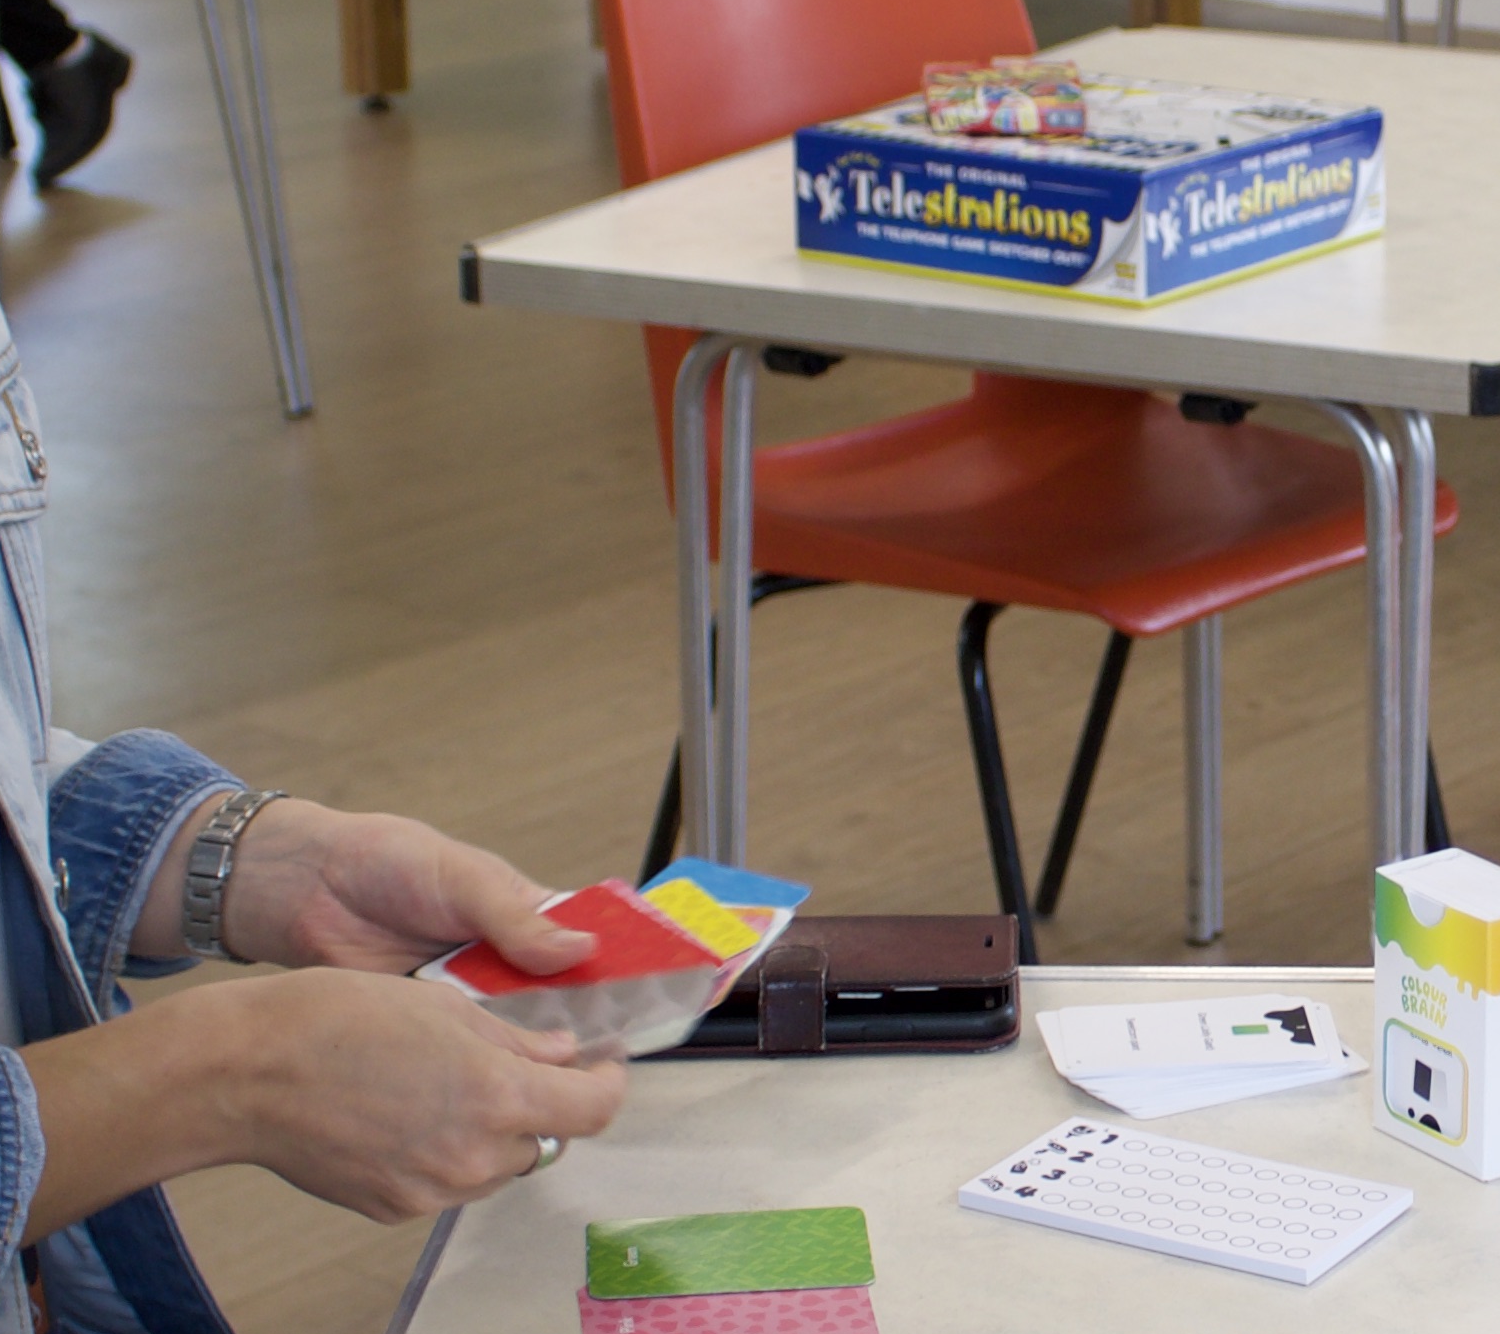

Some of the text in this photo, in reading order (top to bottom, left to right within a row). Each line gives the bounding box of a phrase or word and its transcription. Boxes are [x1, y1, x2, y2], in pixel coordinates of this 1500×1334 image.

[925, 161, 1028, 191] THE ORIGINAL
[849, 167, 1091, 247] Telestrations
[1184, 157, 1354, 237] Telestrations
[856, 222, 880, 240] THE
[883, 226, 948, 249] TELEPHONE
[1401, 975, 1448, 1010] COLOUR
[1401, 994, 1448, 1030] BRAIN
[1068, 1150, 1094, 1163] 2
[1041, 1169, 1067, 1181] 3
[1014, 1186, 1038, 1198] 4
[623, 1246, 638, 1268] Green
[619, 1316, 635, 1334] Pink
